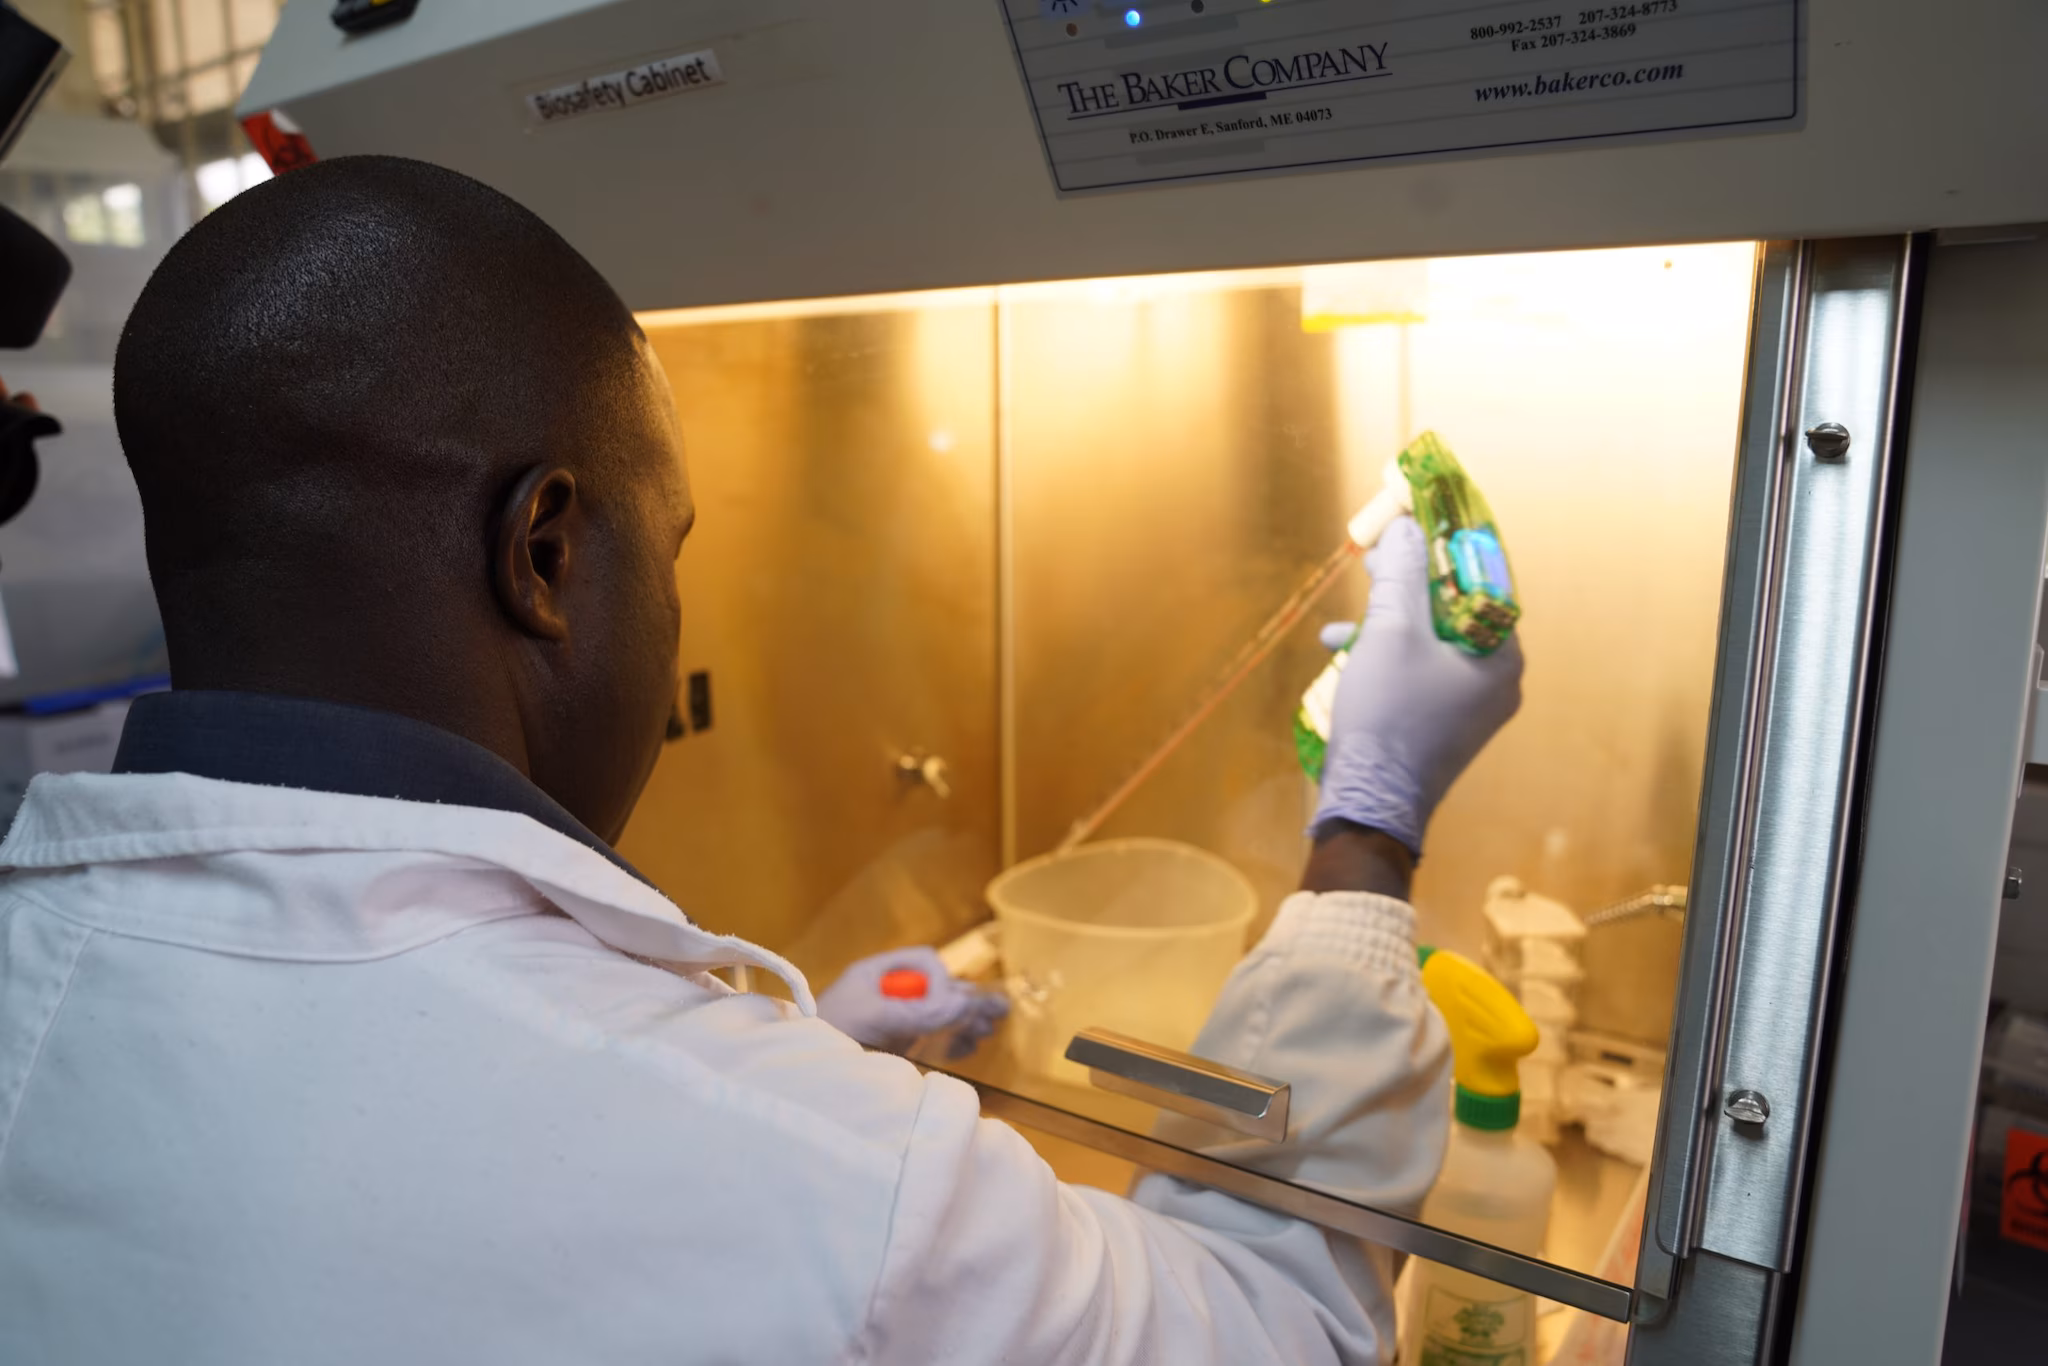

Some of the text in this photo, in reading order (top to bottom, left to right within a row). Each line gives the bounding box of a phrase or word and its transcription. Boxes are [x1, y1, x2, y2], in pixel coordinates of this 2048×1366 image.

[1470, 0, 1678, 40] 800-992-2537 207-324-8773
[1511, 23, 1637, 52] Fax 207-324-3869
[534, 57, 712, 121] Biosafety Cabinet
[1057, 42, 1390, 114] THE BAKER COMPANY
[1475, 63, 1684, 102] www.bakerco.com
[1129, 108, 1333, 144] P.O. Drawer E, Sanford, ME 04073
